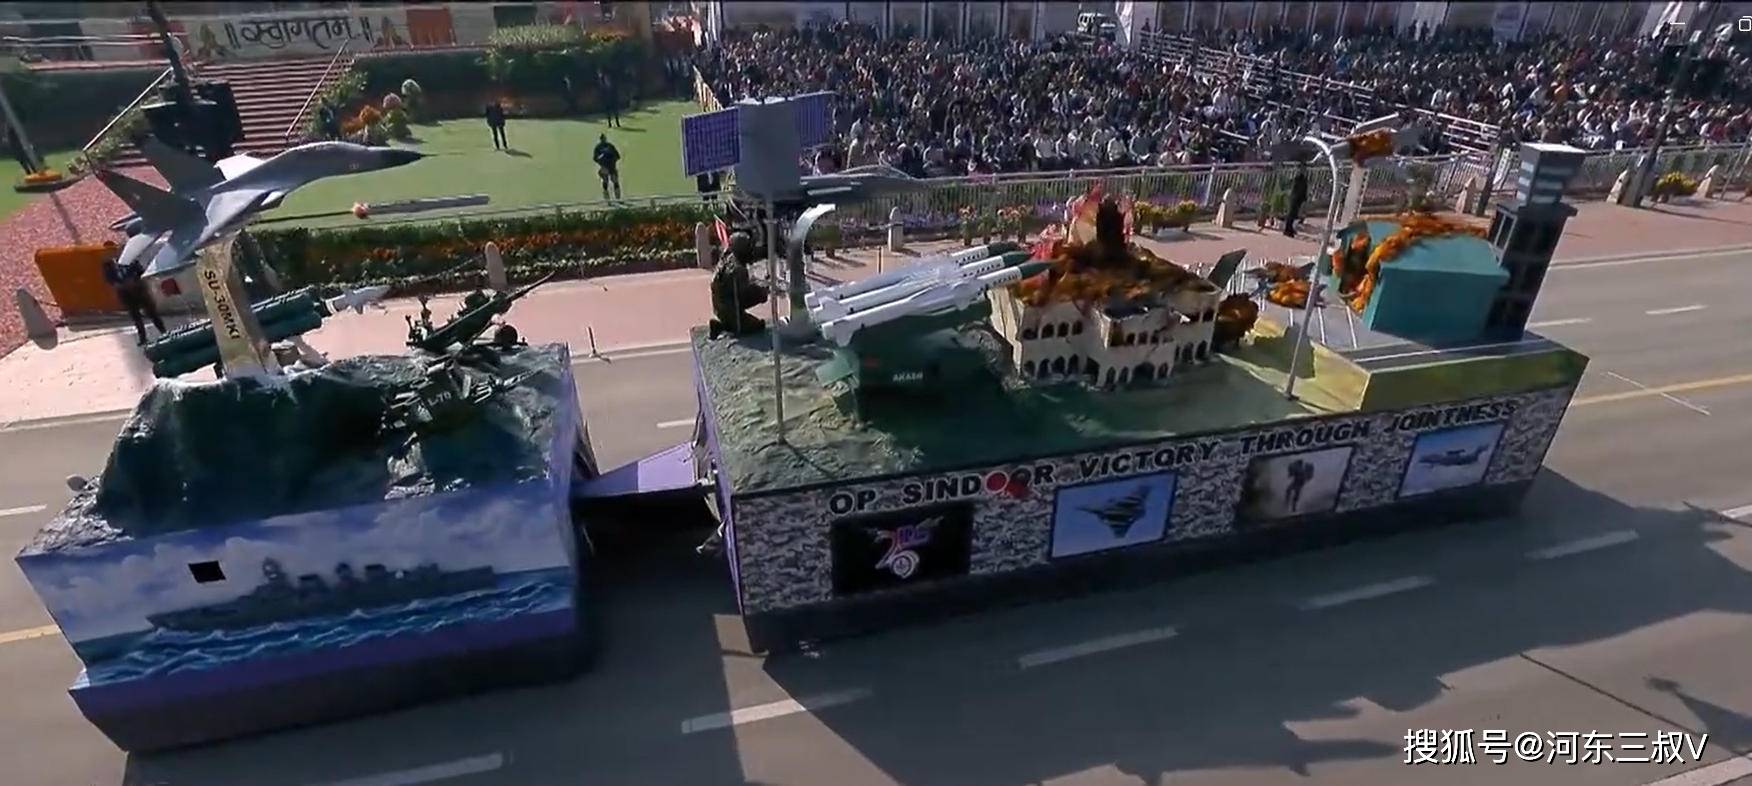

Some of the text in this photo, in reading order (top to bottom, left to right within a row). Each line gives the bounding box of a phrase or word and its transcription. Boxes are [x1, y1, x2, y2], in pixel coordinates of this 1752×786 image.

[204, 270, 241, 340] SU-30MKI
[829, 400, 1518, 515] OP SINDOOR VICTORY THROUGH JOINTNESS
